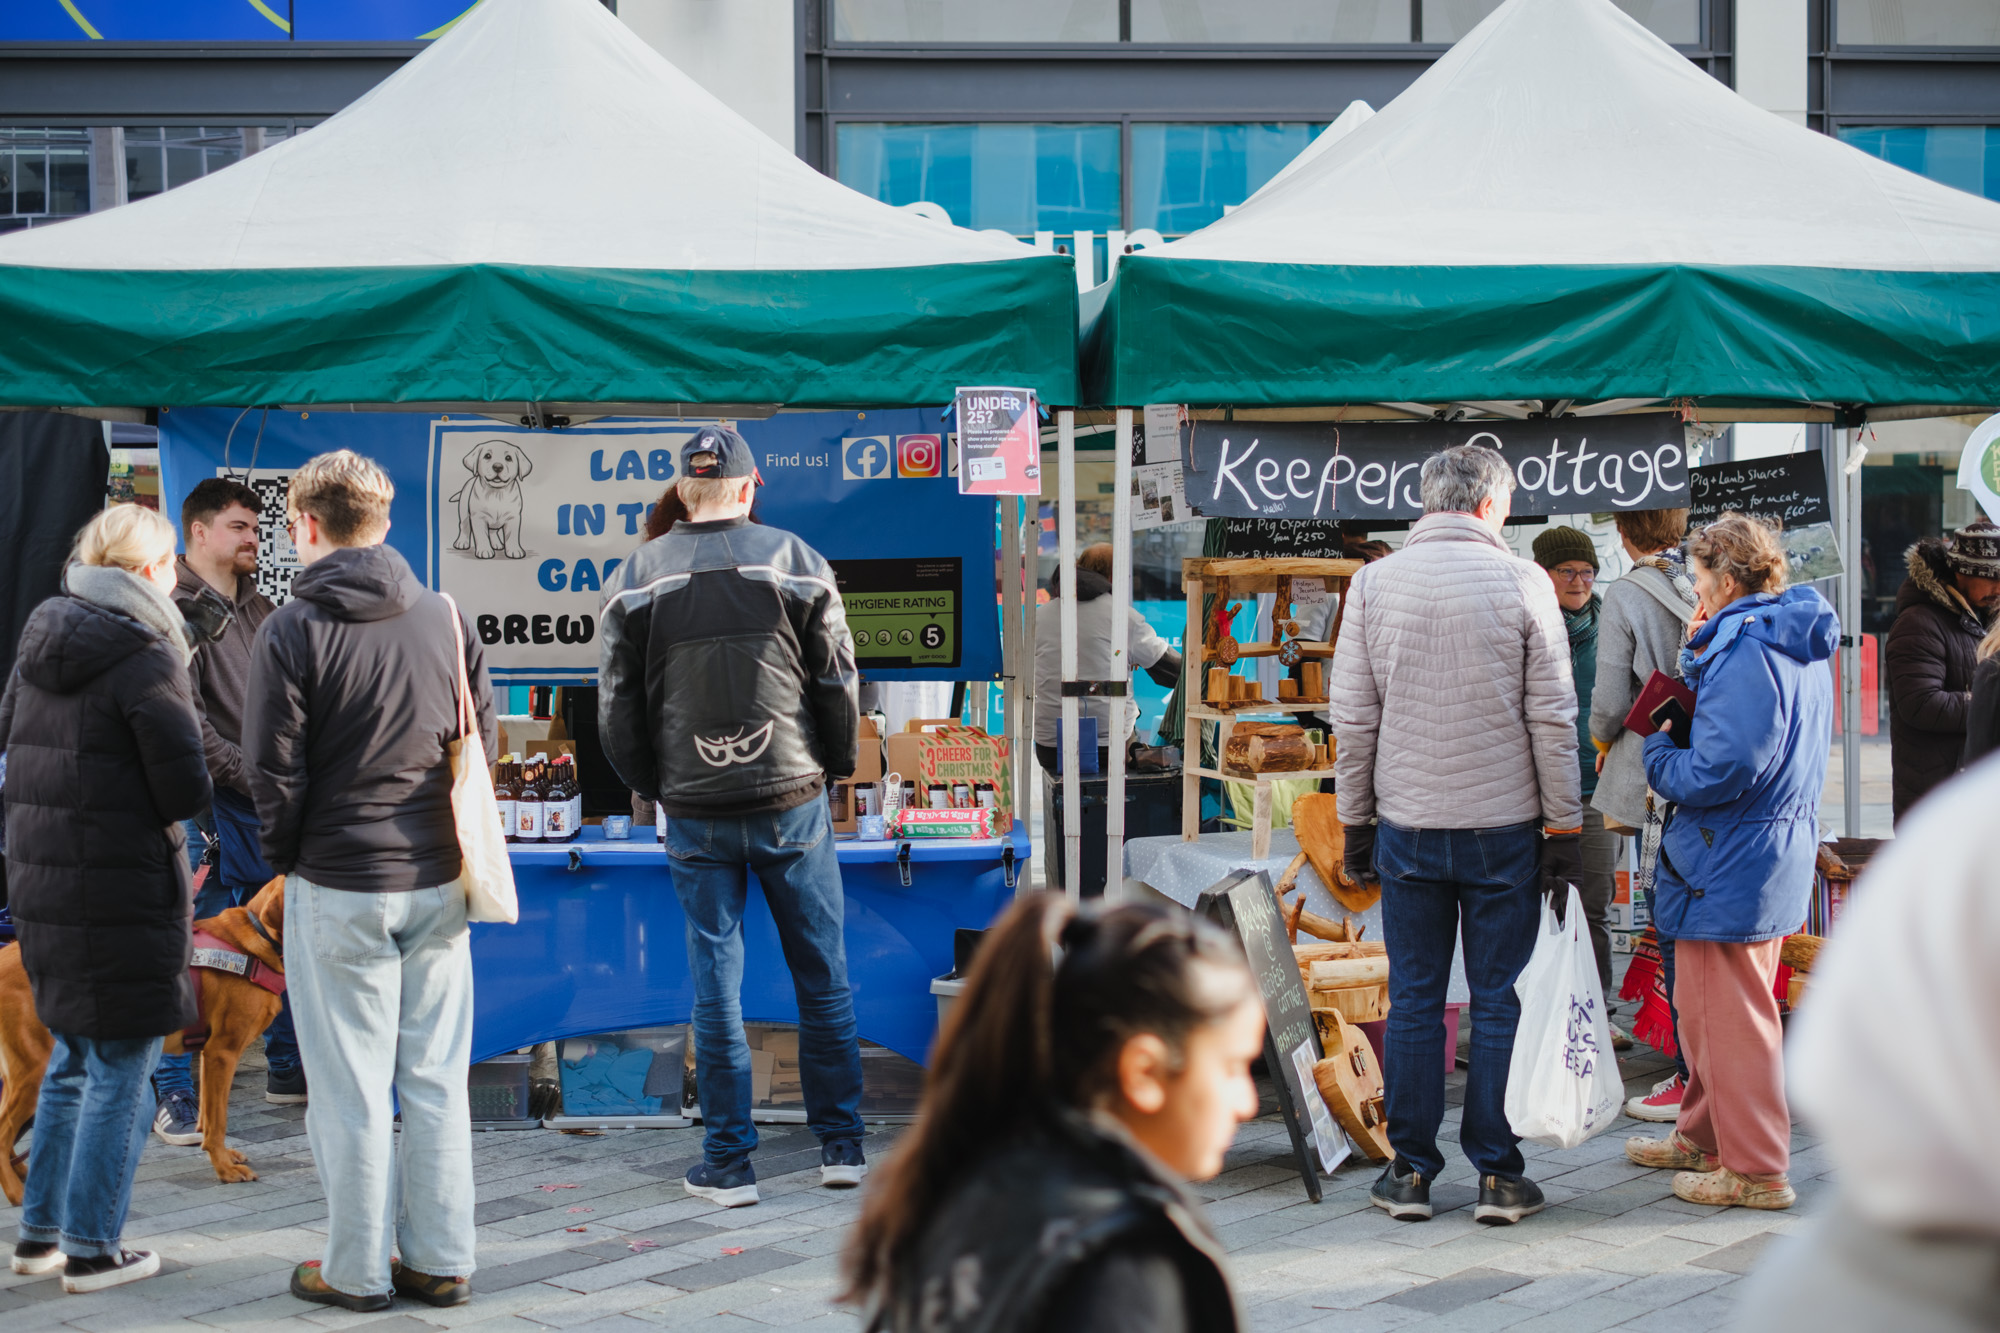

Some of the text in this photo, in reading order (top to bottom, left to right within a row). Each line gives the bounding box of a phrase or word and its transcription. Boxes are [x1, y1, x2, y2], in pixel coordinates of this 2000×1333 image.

[967, 396, 1021, 411] UNDER
[967, 410, 994, 424] 25?
[590, 449, 675, 481] LAB
[766, 452, 830, 467] Find us!
[1690, 472, 1710, 498] Pig
[1719, 470, 1745, 485] Lamb
[1263, 501, 1287, 515] Hello!
[1721, 498, 1744, 511] now
[1750, 494, 1764, 510] for
[557, 502, 659, 536] IN T
[1227, 520, 1253, 535] Half
[1257, 518, 1277, 539] Pig
[1273, 531, 1326, 546] from £250
[849, 596, 946, 610] HYGIENE RATING
[477, 614, 595, 645] BREW
[858, 627, 940, 647] 2 3 4 5
[926, 747, 991, 777] 3 CHEERS FOR
[936, 762, 993, 777] CHRISTMAS
[208, 958, 244, 973] BREWNG
